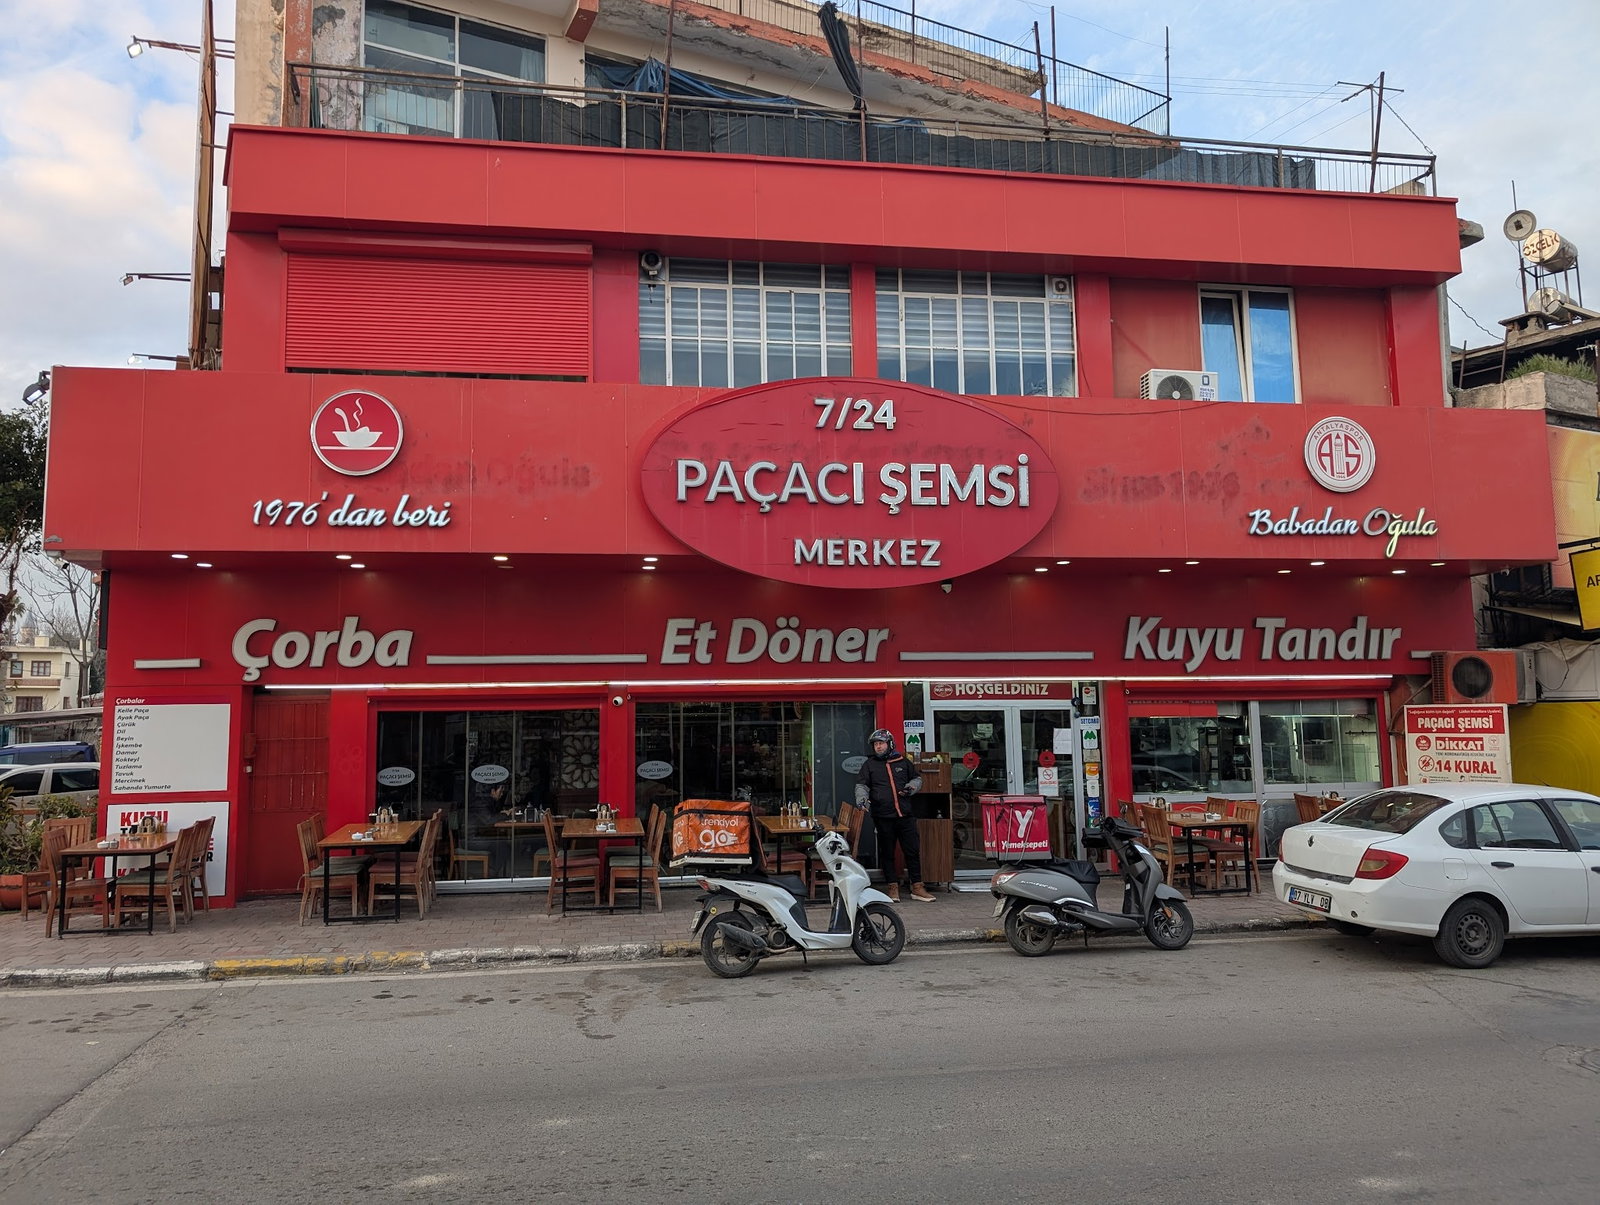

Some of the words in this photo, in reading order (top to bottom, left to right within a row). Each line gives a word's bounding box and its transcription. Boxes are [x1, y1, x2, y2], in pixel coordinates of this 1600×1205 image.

[814, 397, 897, 430] 7/24
[1313, 422, 1364, 442] ANTALYASPOR
[675, 458, 865, 512] PAÇACI
[878, 453, 1031, 514] ŞEMSİ
[392, 493, 452, 527] beri
[1247, 506, 1360, 537] Babadan
[1362, 507, 1439, 559] Oğula
[793, 538, 942, 567] MERKEZ
[231, 616, 414, 682] Çorba
[660, 617, 718, 665] Et
[725, 616, 890, 665] Döner
[1123, 615, 1245, 674] Kuyu
[1254, 615, 1402, 661] Tandır
[115, 697, 146, 705] Çorbalar
[1417, 717, 1455, 732] PAÇACI
[1457, 714, 1494, 732] ŞEMSİ
[1436, 737, 1483, 750] DİKKAT
[1436, 760, 1452, 773] 14
[1454, 760, 1498, 775] KURAL
[1001, 839, 1049, 850] Yemeksepeti
